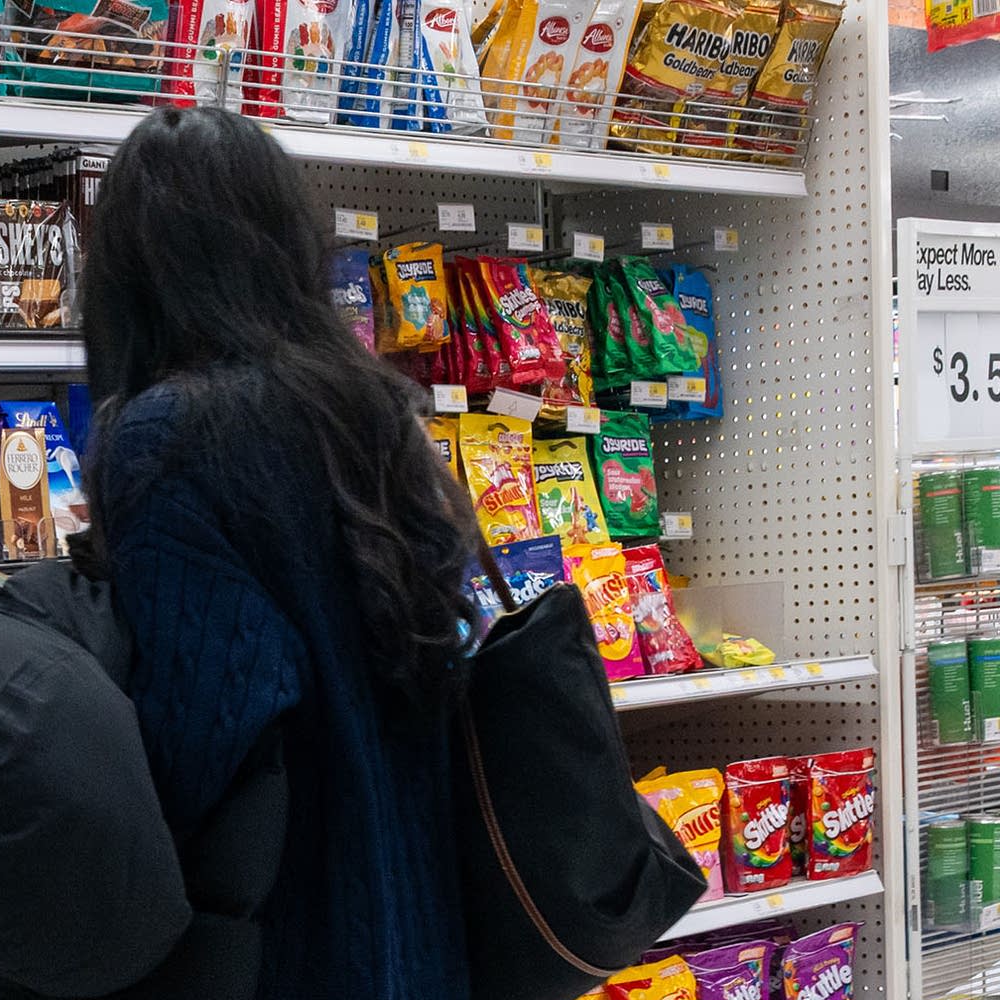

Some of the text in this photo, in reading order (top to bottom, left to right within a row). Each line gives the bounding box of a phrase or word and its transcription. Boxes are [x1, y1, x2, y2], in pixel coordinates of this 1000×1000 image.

[732, 31, 771, 58] RIBO
[663, 53, 715, 79] Goldbears
[961, 243, 997, 266] More.
[937, 268, 971, 291] Less.
[603, 437, 648, 453] JOYRIDE
[7, 454, 38, 464] FERRERO
[7, 461, 39, 472] ROCHER
[743, 801, 790, 850] Skittle
[822, 791, 874, 839] Skittle
